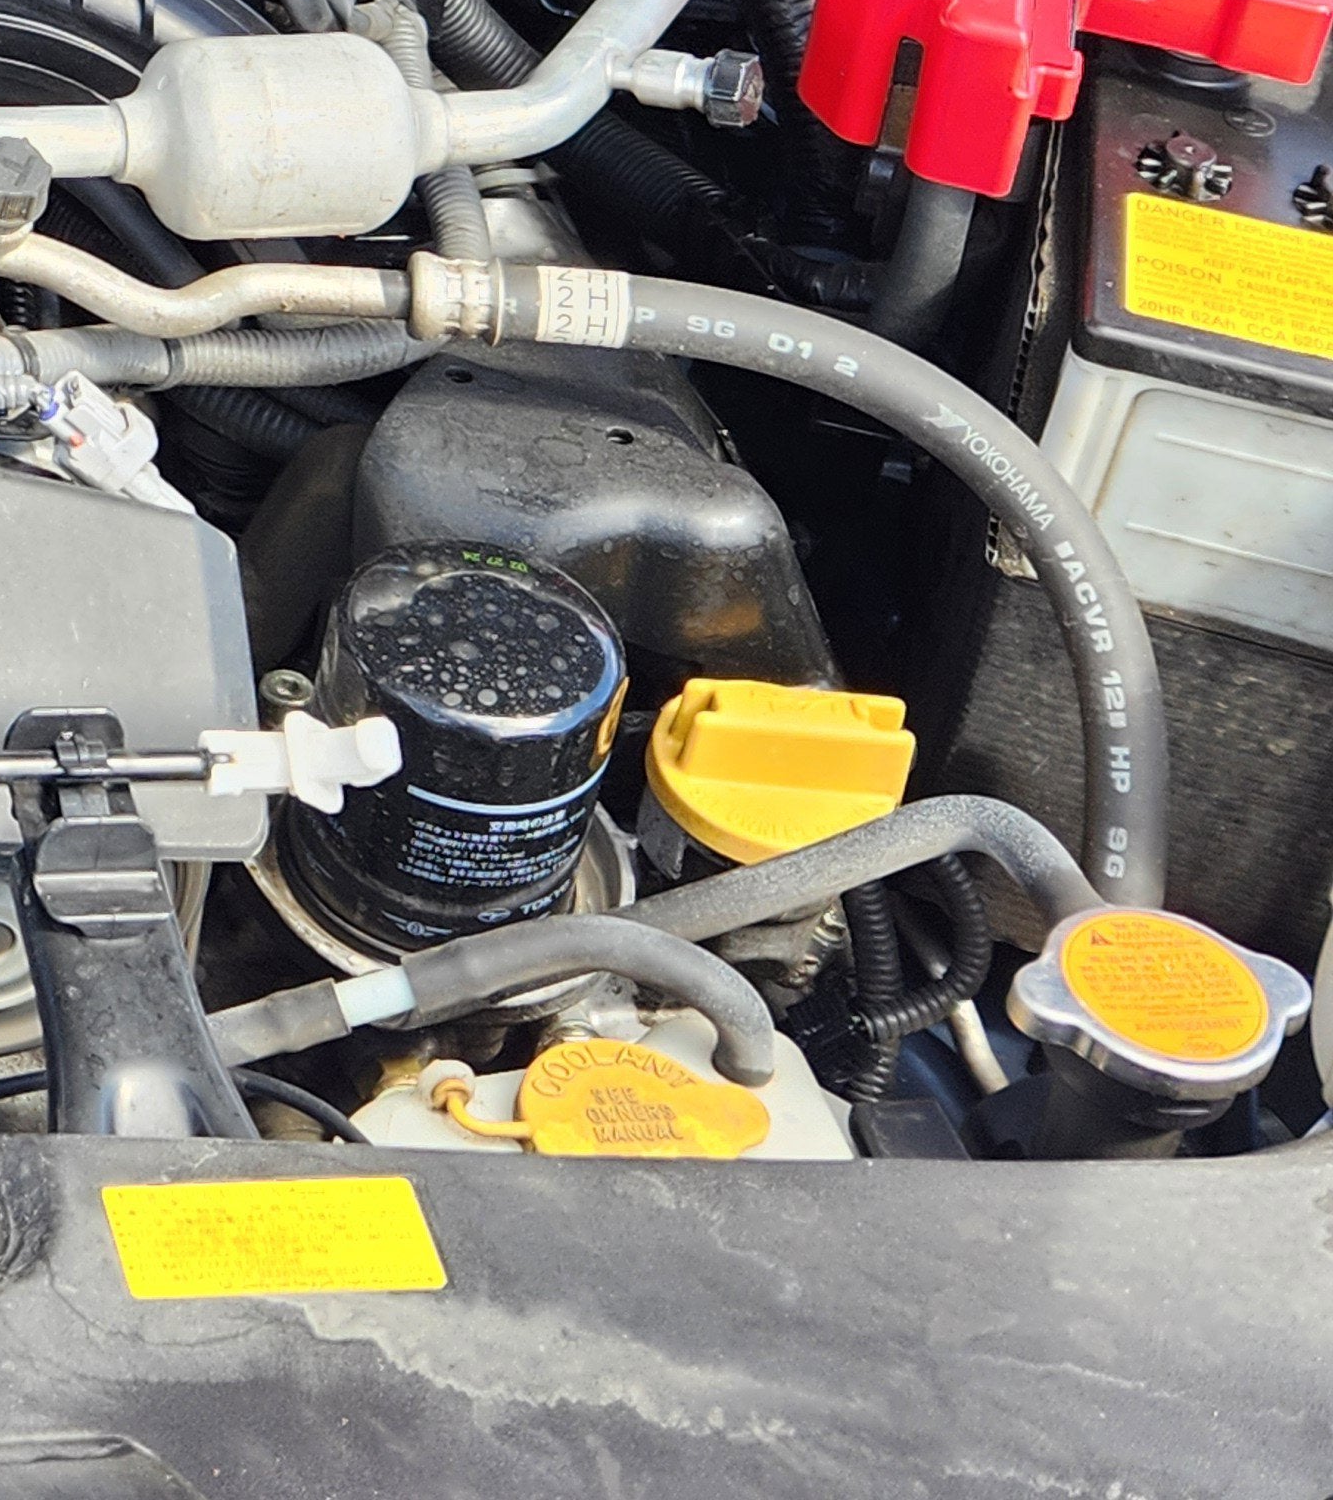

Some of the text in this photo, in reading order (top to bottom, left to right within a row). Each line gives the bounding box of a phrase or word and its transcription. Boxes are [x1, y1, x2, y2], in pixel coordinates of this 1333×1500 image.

[1136, 199, 1227, 229] DANGER
[1135, 254, 1223, 285] POISON
[556, 285, 610, 311] 2 H
[554, 313, 607, 337] 2 H
[1246, 322, 1286, 343] CCA
[961, 423, 1056, 532] YOKOHAMA
[1061, 559, 1115, 654] ACVR
[1109, 745, 1133, 795] HP
[530, 1043, 698, 1098] COOLANT
[590, 1086, 640, 1106] SEE
[592, 1124, 684, 1145] MANUAL
